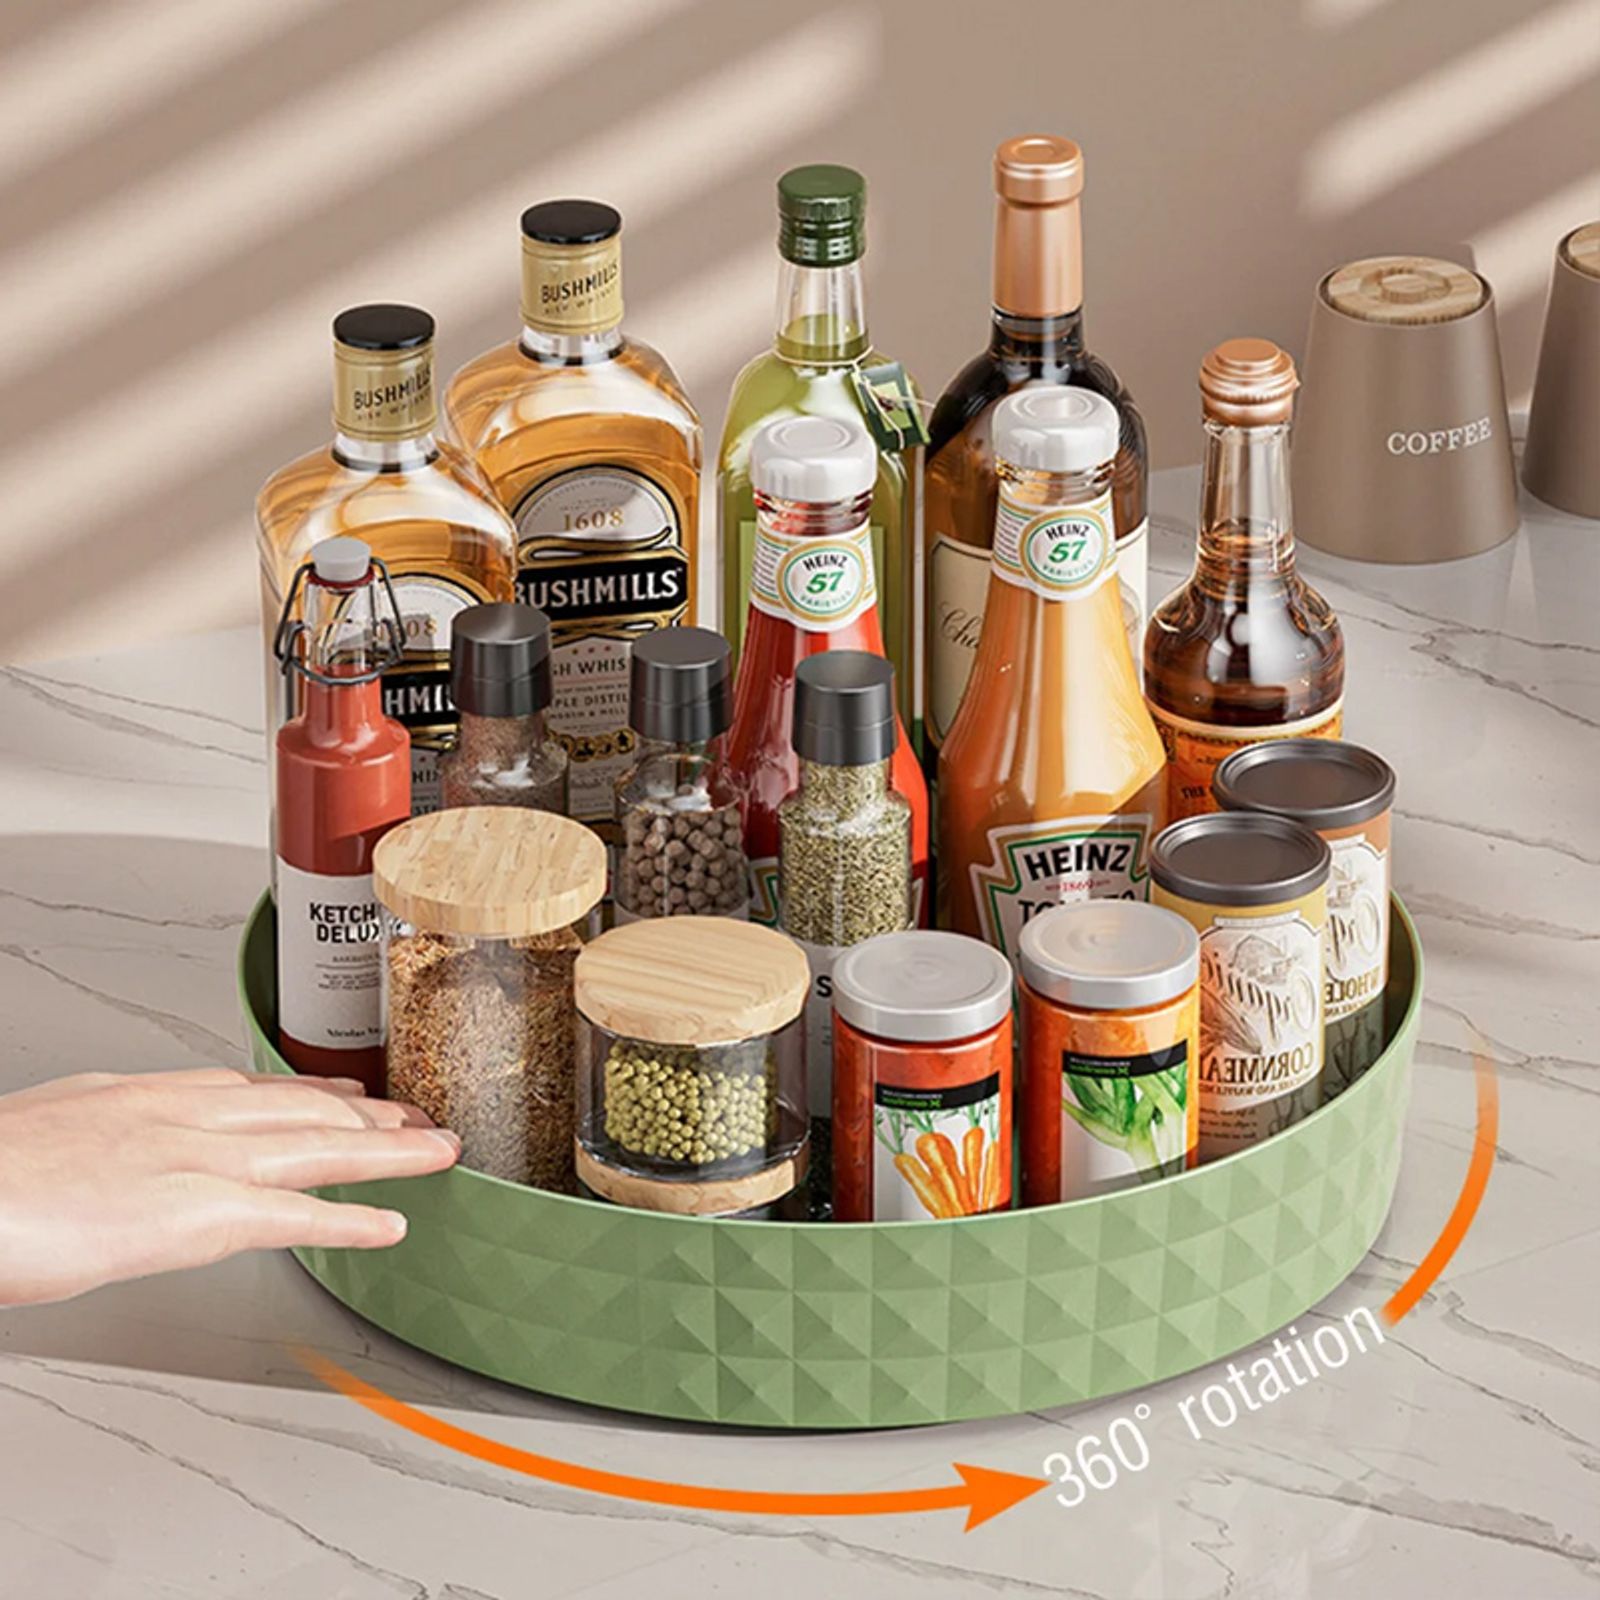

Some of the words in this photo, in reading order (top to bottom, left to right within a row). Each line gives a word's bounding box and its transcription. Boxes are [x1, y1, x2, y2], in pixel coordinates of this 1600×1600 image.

[541, 258, 618, 304] BUSHMILLS
[1387, 416, 1492, 455] COFFEE
[563, 507, 624, 531] 1608
[1045, 523, 1090, 541] HEINZ
[802, 554, 848, 571] HEINZ
[1048, 540, 1087, 563] 57
[806, 571, 844, 594] 57
[1024, 844, 1131, 881] HEINZ
[310, 903, 376, 925] KETCH
